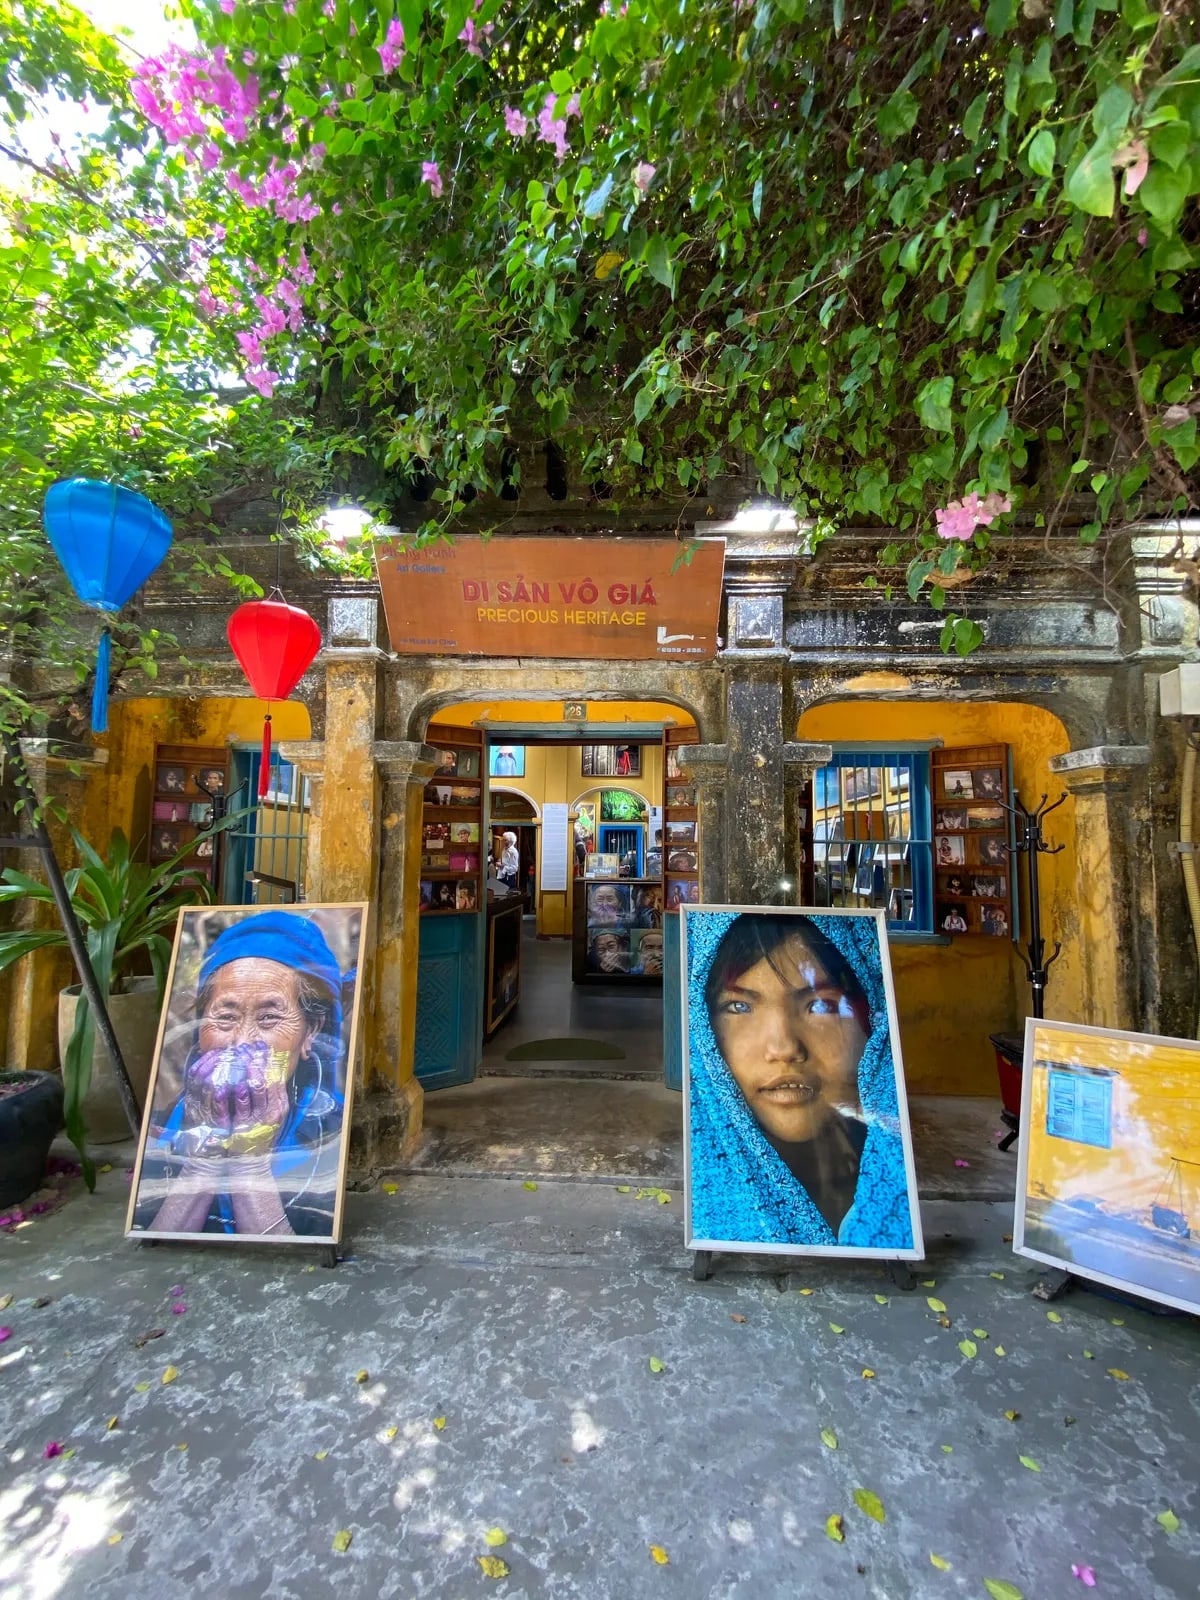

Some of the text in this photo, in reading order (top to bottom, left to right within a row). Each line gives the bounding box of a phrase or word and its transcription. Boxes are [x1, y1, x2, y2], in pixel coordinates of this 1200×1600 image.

[382, 545, 420, 560] Phng
[463, 573, 657, 606] DI SẢN VÔ GIÁ
[477, 607, 647, 626] PRECIOUS HERITAGE
[570, 706, 582, 717] 26
